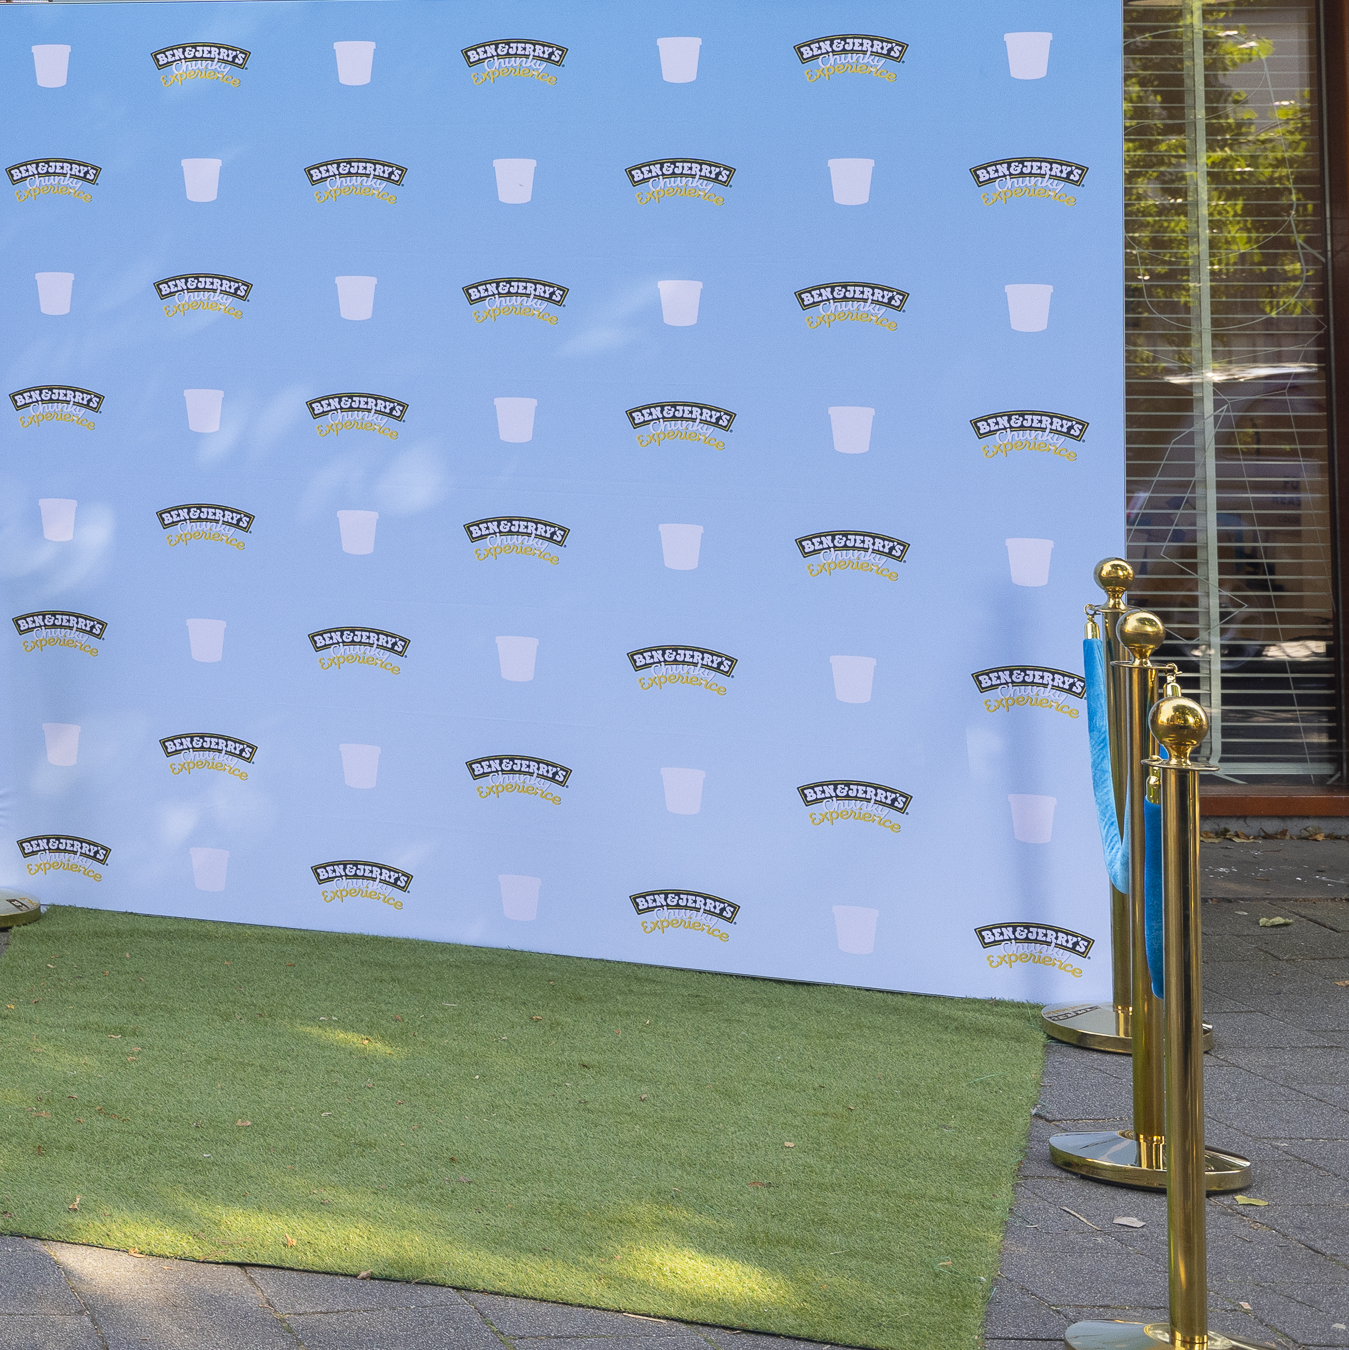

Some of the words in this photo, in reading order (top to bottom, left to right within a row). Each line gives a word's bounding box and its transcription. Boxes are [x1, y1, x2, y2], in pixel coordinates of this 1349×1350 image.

[173, 57, 231, 77] Chunky
[484, 54, 547, 74] Chunky
[805, 60, 897, 82] Experience
[819, 50, 886, 71] Chunky
[161, 67, 241, 87] Experience
[472, 64, 557, 85] Experience
[15, 182, 92, 202] Experience
[26, 173, 83, 192] Chunky
[326, 173, 387, 193] Chunky
[649, 174, 714, 194] Chunky
[995, 173, 1065, 195] Chunky
[315, 183, 397, 204] Experience
[636, 184, 725, 205] Experience
[981, 184, 1076, 206] Experience
[164, 298, 243, 319] Experience
[175, 288, 233, 308] Chunky
[485, 293, 548, 313] Chunky
[819, 298, 886, 319] Chunky
[473, 303, 558, 325] Experience
[806, 308, 897, 331] Experience
[19, 409, 95, 430] Experience
[30, 400, 86, 419] Chunky
[328, 408, 388, 428] Chunky
[316, 418, 398, 439] Experience
[649, 418, 714, 438] Chunky
[996, 427, 1065, 449] Chunky
[637, 428, 725, 450] Experience
[982, 438, 1077, 461] Experience
[166, 528, 245, 550] Experience
[474, 542, 559, 564] Experience
[807, 557, 898, 581] Experience
[22, 635, 98, 656] Experience
[318, 652, 400, 674] Experience
[638, 672, 726, 695] Experience
[983, 693, 1079, 719] Experience
[169, 758, 248, 780] Experience
[476, 781, 561, 804] Experience
[809, 808, 900, 832] Experience
[26, 859, 102, 881] Experience
[321, 886, 403, 909] Experience
[640, 917, 729, 941] Experience
[986, 951, 1082, 977] Experience
